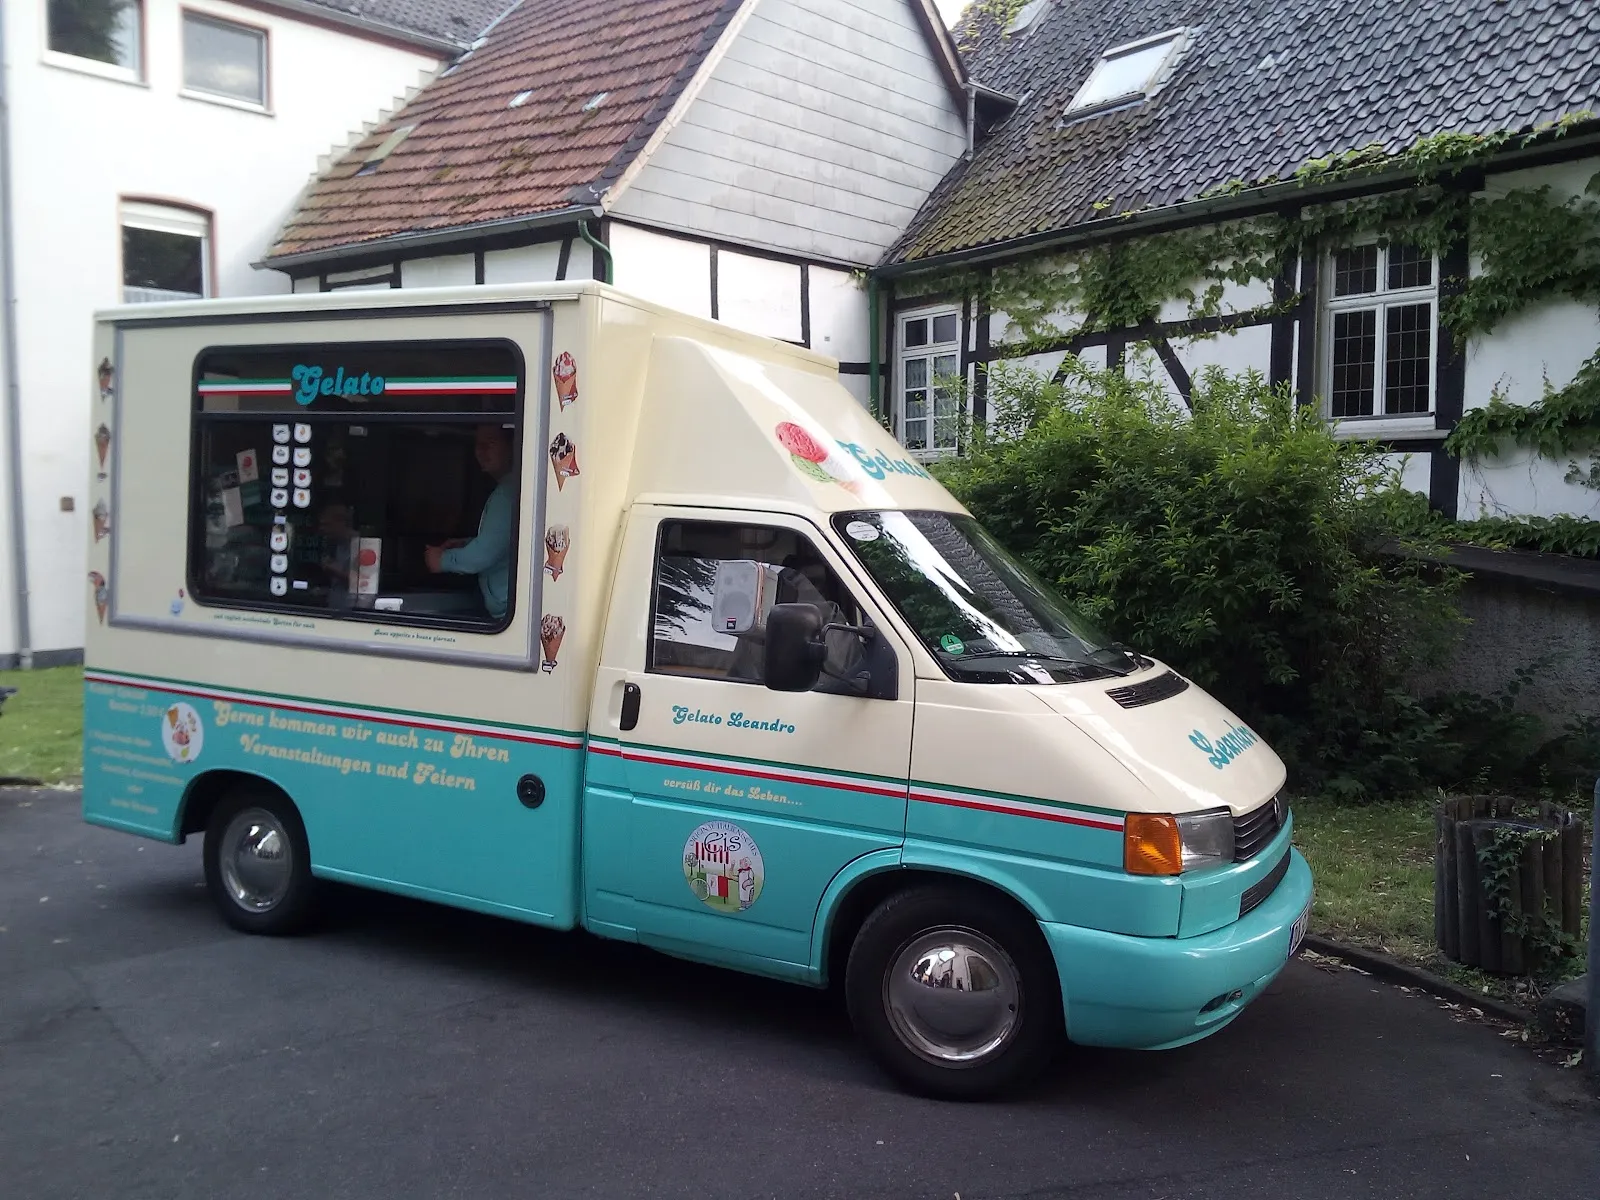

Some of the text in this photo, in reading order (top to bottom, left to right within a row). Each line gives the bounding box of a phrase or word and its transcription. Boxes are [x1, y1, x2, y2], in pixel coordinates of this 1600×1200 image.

[292, 364, 385, 405] Gelato
[213, 700, 510, 762] Gerne kommen wir auch zu Ihren
[672, 705, 796, 733] Gelato Leandro
[240, 733, 476, 791] Veranstaltungen und Feiern
[663, 779, 701, 792] versüß
[704, 782, 721, 794] dir
[724, 784, 744, 798] das
[704, 831, 742, 854] Eis
